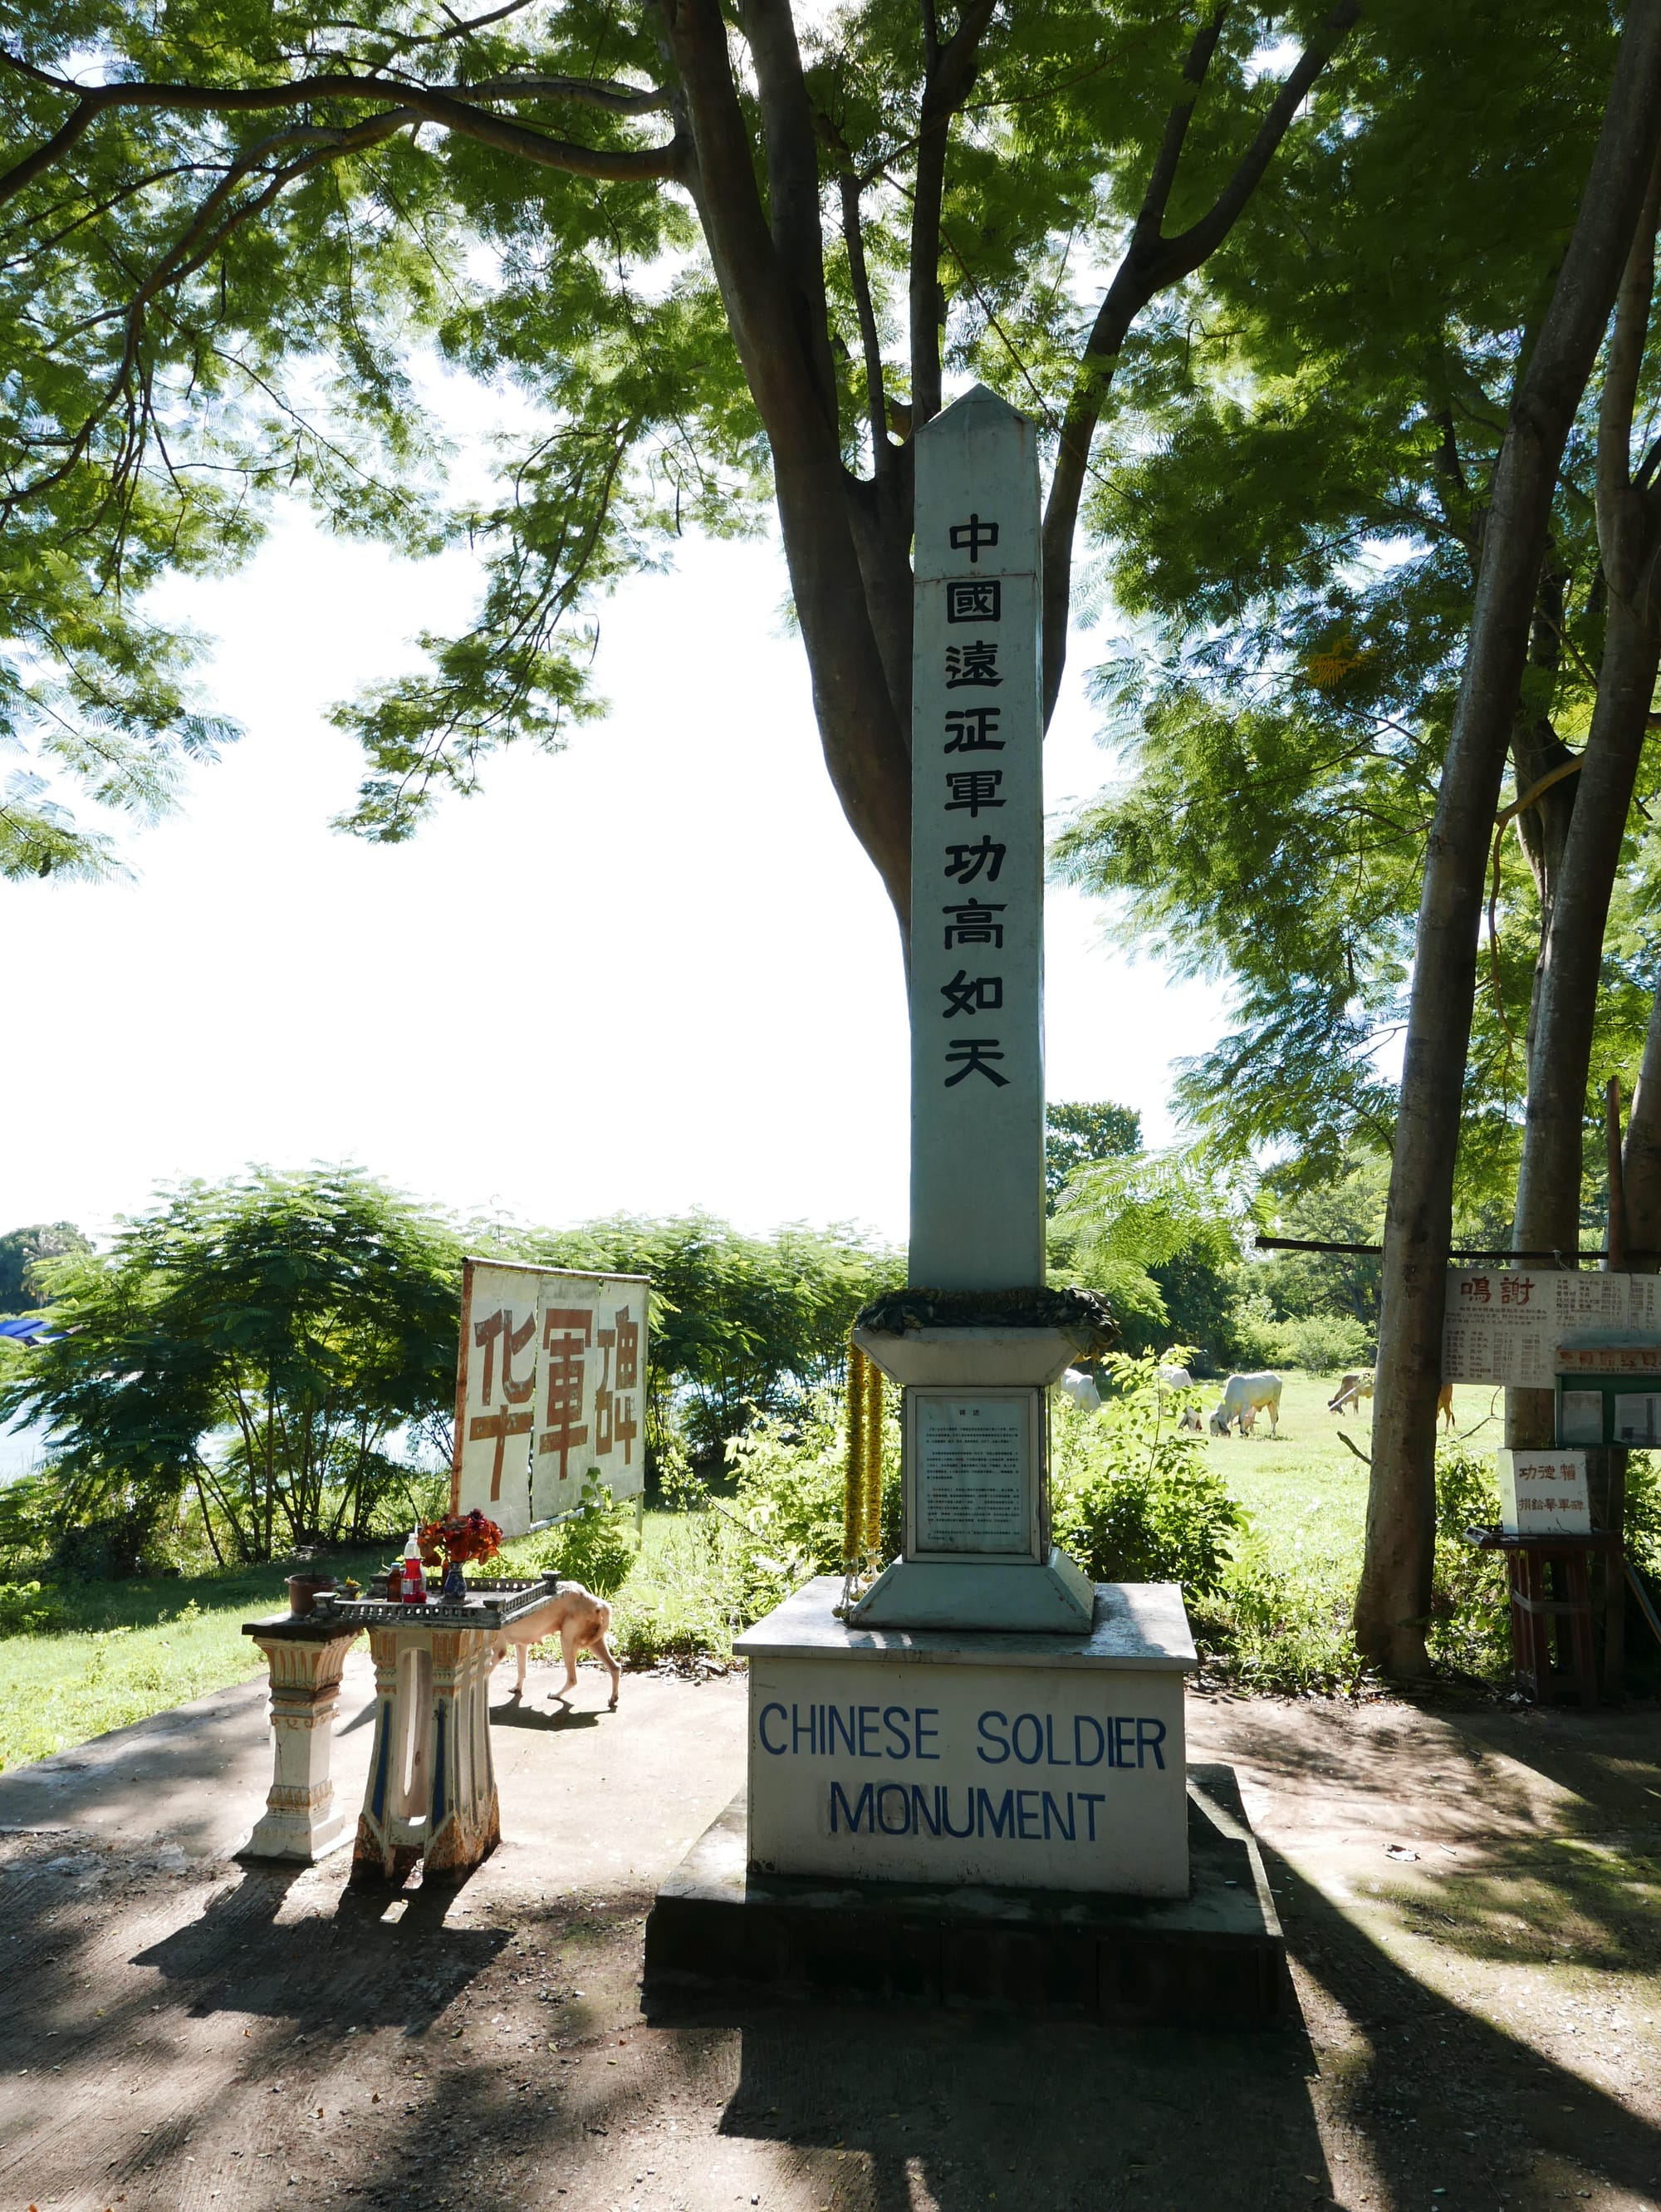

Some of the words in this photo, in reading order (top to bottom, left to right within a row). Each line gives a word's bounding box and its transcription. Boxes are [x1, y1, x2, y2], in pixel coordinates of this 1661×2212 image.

[940, 513, 1011, 1088] 中國遠征軍功高如天
[1460, 1276, 1536, 1307] 鳴謝
[759, 1702, 940, 1760] CHINESE
[976, 1710, 1168, 1771] SOLDIER
[830, 1781, 1106, 1842] MONUMENT
